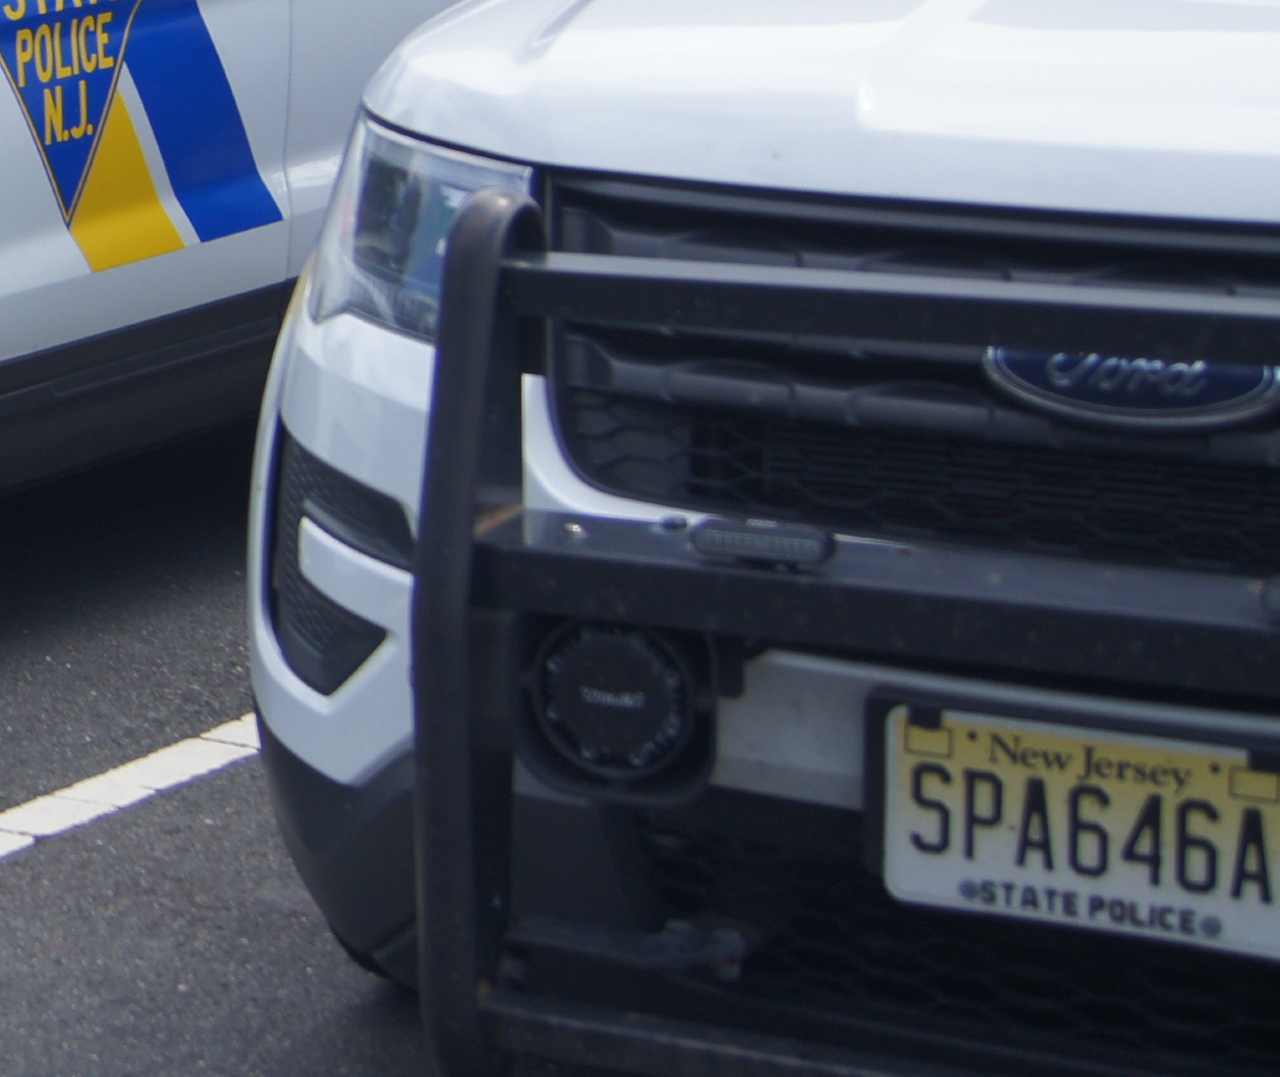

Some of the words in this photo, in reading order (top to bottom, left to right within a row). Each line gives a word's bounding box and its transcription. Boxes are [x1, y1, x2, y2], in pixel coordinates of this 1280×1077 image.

[16, 12, 114, 87] POLICE
[43, 80, 94, 145] N.J.
[989, 733, 1073, 768] New
[1078, 745, 1191, 792] Jersey
[910, 761, 1272, 905] SPA646A
[981, 880, 1079, 917] STATE
[1088, 895, 1196, 934] POLICE
